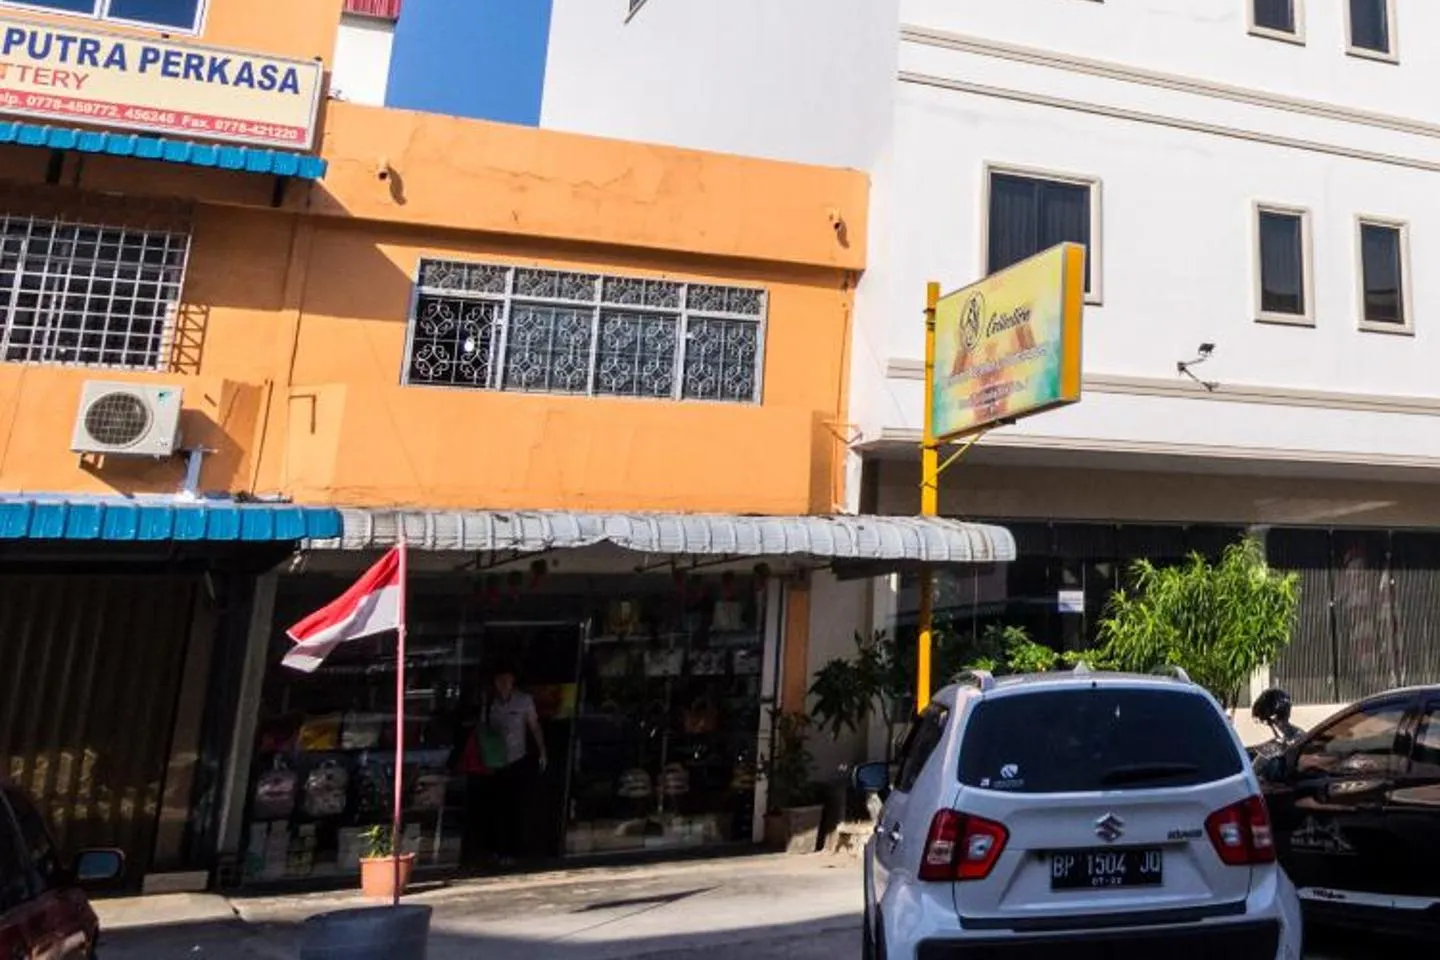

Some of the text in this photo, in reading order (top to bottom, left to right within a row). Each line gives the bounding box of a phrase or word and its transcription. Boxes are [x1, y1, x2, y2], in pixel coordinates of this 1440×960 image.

[2, 26, 300, 94] PUTRA PERKASA
[1053, 854, 1075, 878] BP
[1087, 852, 1127, 876] 1504
